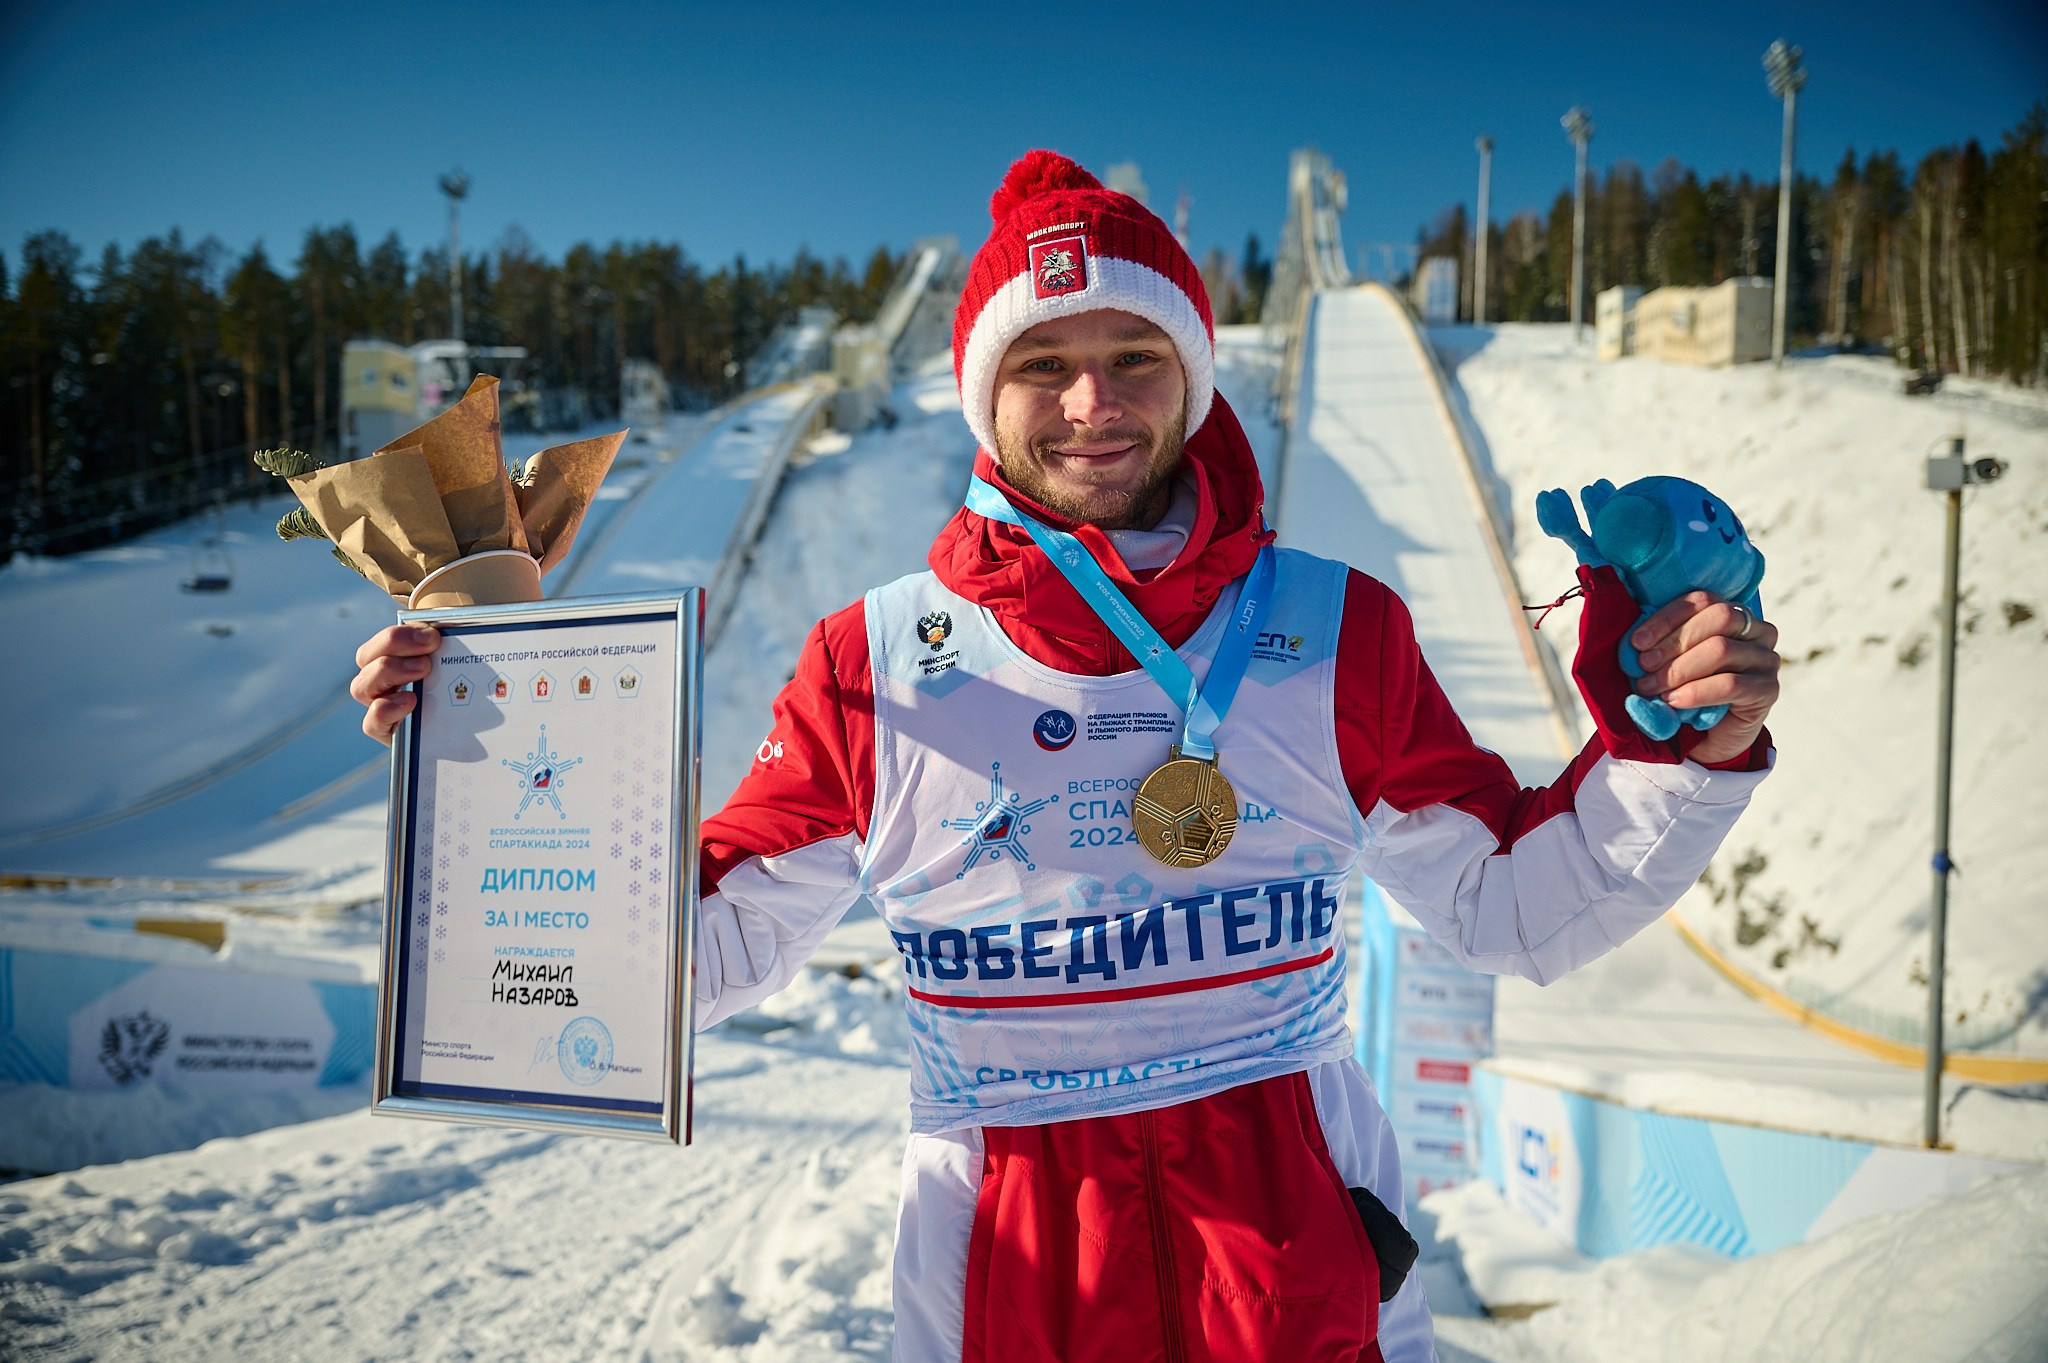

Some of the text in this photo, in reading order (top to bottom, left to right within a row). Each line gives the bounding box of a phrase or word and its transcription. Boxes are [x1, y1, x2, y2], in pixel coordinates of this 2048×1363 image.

[1096, 581, 1145, 637] СПАРТАКИАДА 2024
[441, 643, 656, 665] МИНИСТЕРСТВО СПОРТА РОССИЙСКОЙ ФЕДЕРАЦИИ
[918, 650, 960, 667] МИНСПОРТ
[924, 661, 956, 675] РОССИИ
[1068, 778, 1141, 794] ВСЕРОС
[490, 827, 556, 836] ВСЕРОССИЙСКАЯ
[489, 839, 590, 849] СПАРТАКИАДА 2024
[480, 868, 596, 894] ДИПЛОМ
[484, 910, 589, 929] ЗА I МЕСТО
[891, 878, 1338, 984] ПОБЕДИТЕЛЬ
[494, 946, 575, 958] НАГРАЖДАЕТСЯ
[421, 1040, 449, 1049] Министр
[421, 1049, 495, 1061] Российской Федерации
